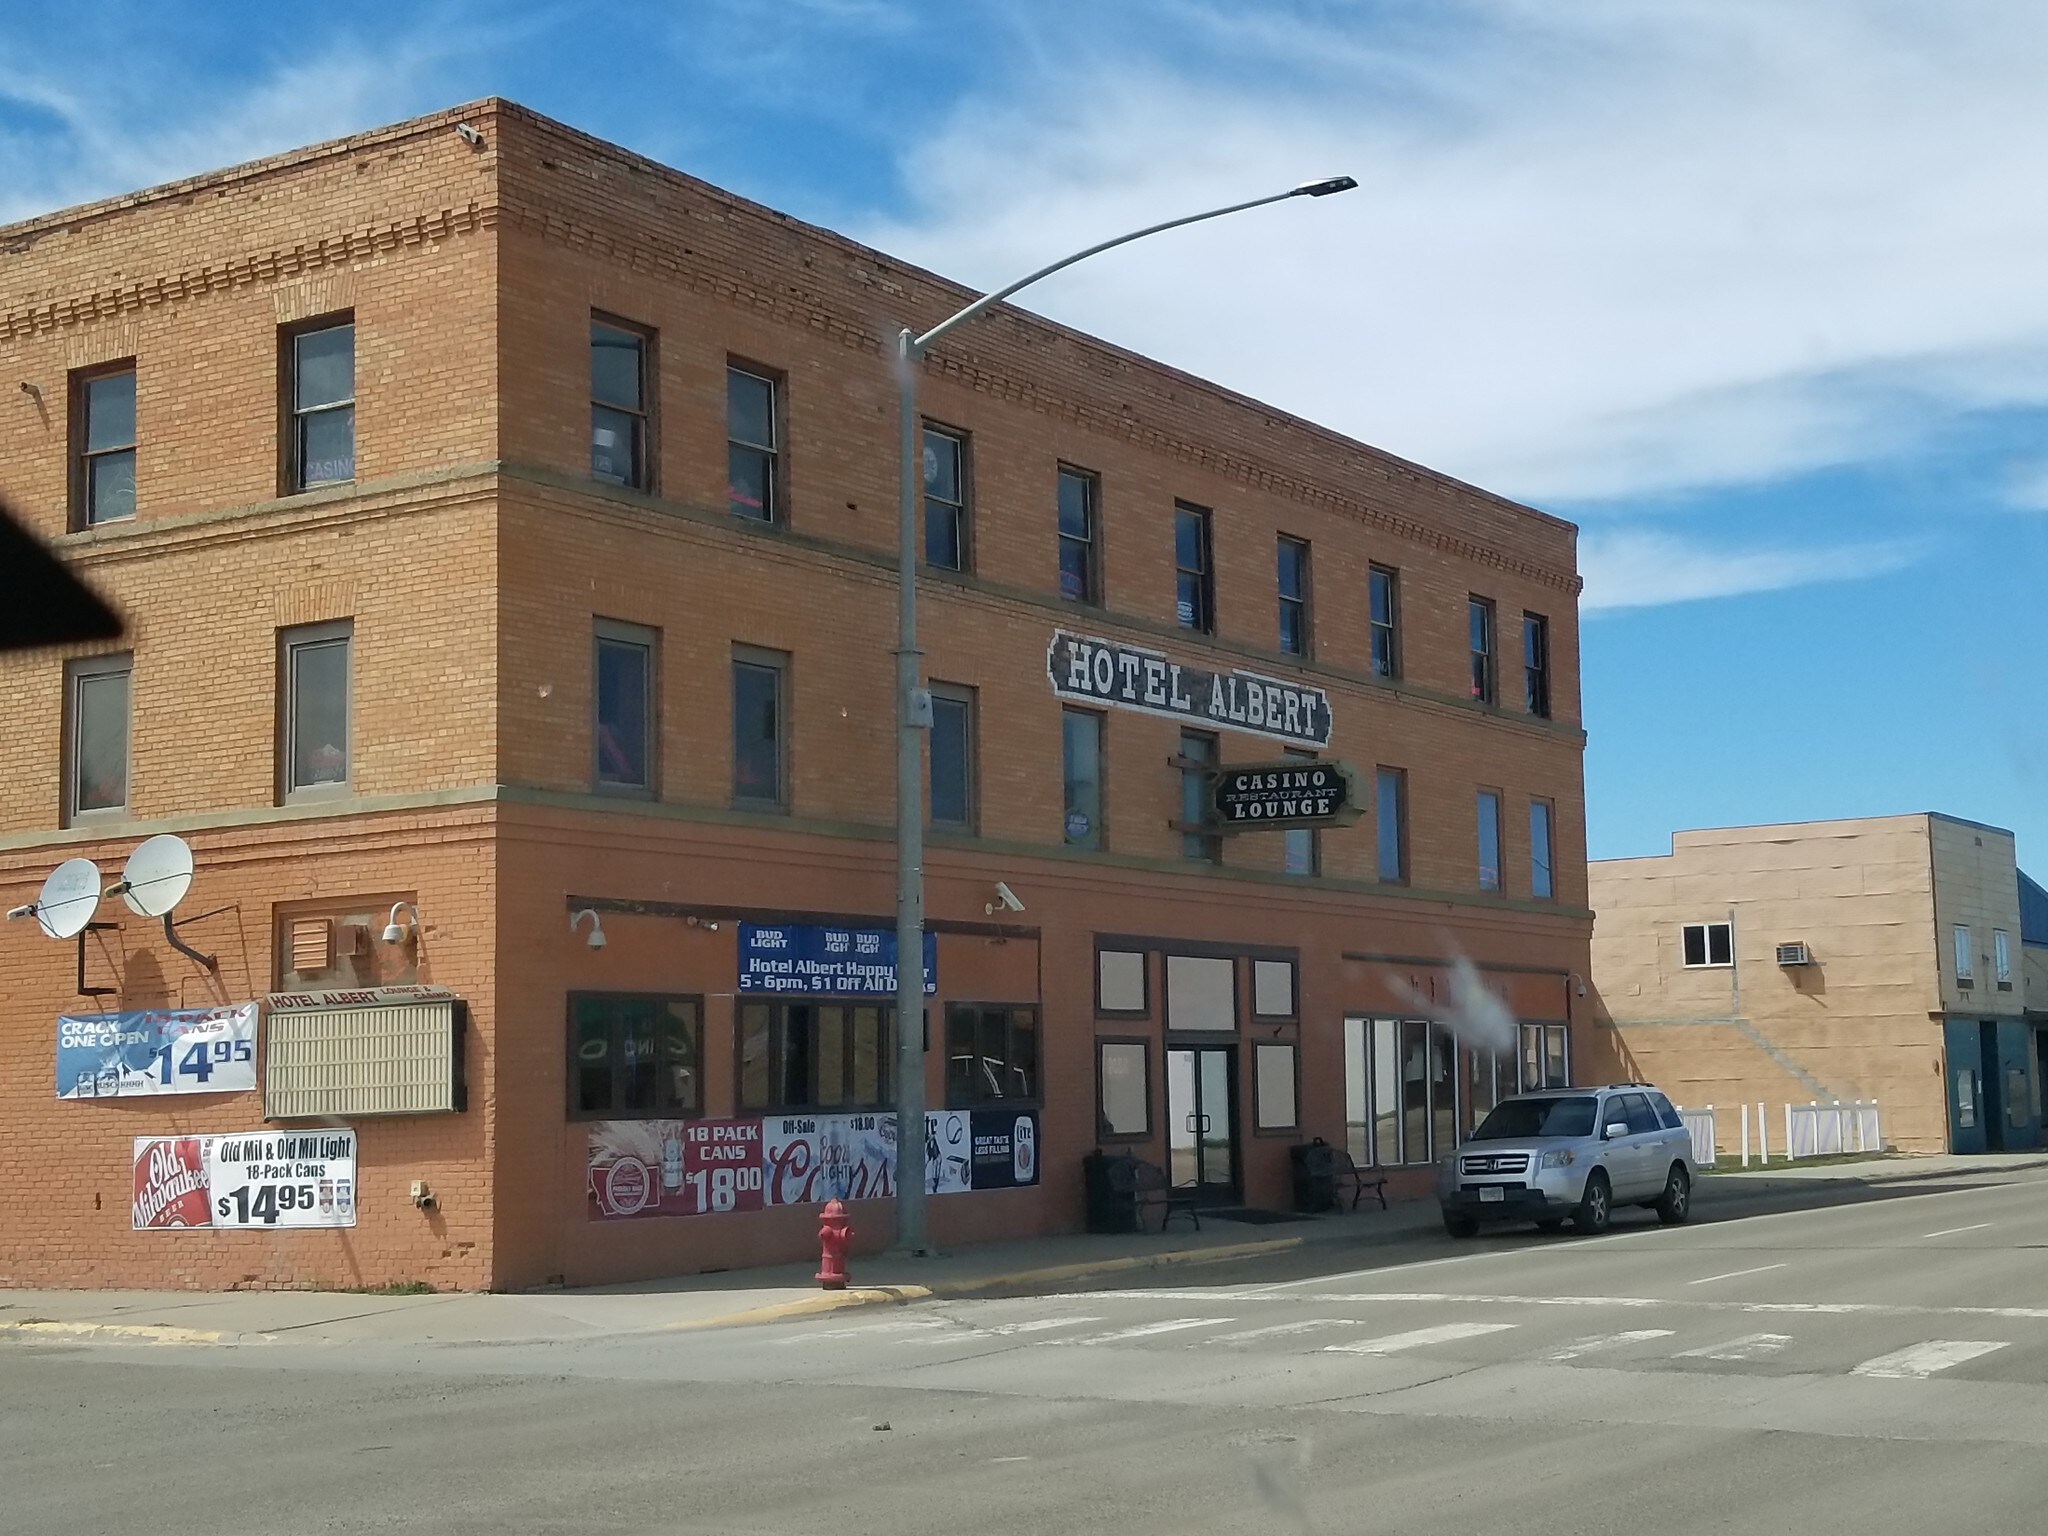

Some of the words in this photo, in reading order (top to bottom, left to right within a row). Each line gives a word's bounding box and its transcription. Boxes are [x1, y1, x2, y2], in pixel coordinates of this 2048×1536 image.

[1067, 641, 1191, 711] HOTEL
[1209, 673, 1317, 737] ALBERT
[1236, 771, 1325, 790] CASINO
[1226, 788, 1337, 802] RESTAURANT
[1235, 799, 1329, 818] LOUNGE
[756, 930, 783, 939] BUD
[825, 933, 849, 942] BUD
[856, 934, 879, 944] BUD
[750, 938, 788, 948] LIGHT
[750, 958, 792, 973] Hotel
[795, 960, 843, 975] Albert
[846, 962, 893, 979] Happy
[380, 986, 421, 995] LOUNGE
[740, 974, 751, 988] 5
[764, 976, 808, 991] 6pm,
[812, 976, 831, 990] $1
[836, 977, 861, 990] Off
[863, 977, 884, 991] All
[270, 993, 319, 1009] HOTEL
[322, 991, 379, 1006] ALBERT
[414, 991, 451, 999] CASINO
[61, 1020, 119, 1035] CRACK
[61, 1034, 96, 1049] ONE
[100, 1031, 149, 1047] OPEN
[783, 1120, 815, 1134] Off-Sale
[851, 1117, 875, 1131] $18.00
[688, 1127, 708, 1141] 18
[713, 1125, 758, 1141] PACK
[221, 1141, 240, 1162] Old
[243, 1140, 263, 1161] Mil
[266, 1144, 274, 1160] &
[277, 1138, 296, 1160] Old
[299, 1138, 317, 1160] Mil
[320, 1136, 350, 1161] Light
[701, 1145, 746, 1160] CANS
[150, 1142, 181, 1188] Old
[246, 1164, 292, 1179] 18-Pack
[296, 1163, 325, 1178] Cans
[770, 1139, 893, 1204] Crs
[134, 1157, 210, 1227] Milwaukee
[159, 1200, 184, 1223] BEER
